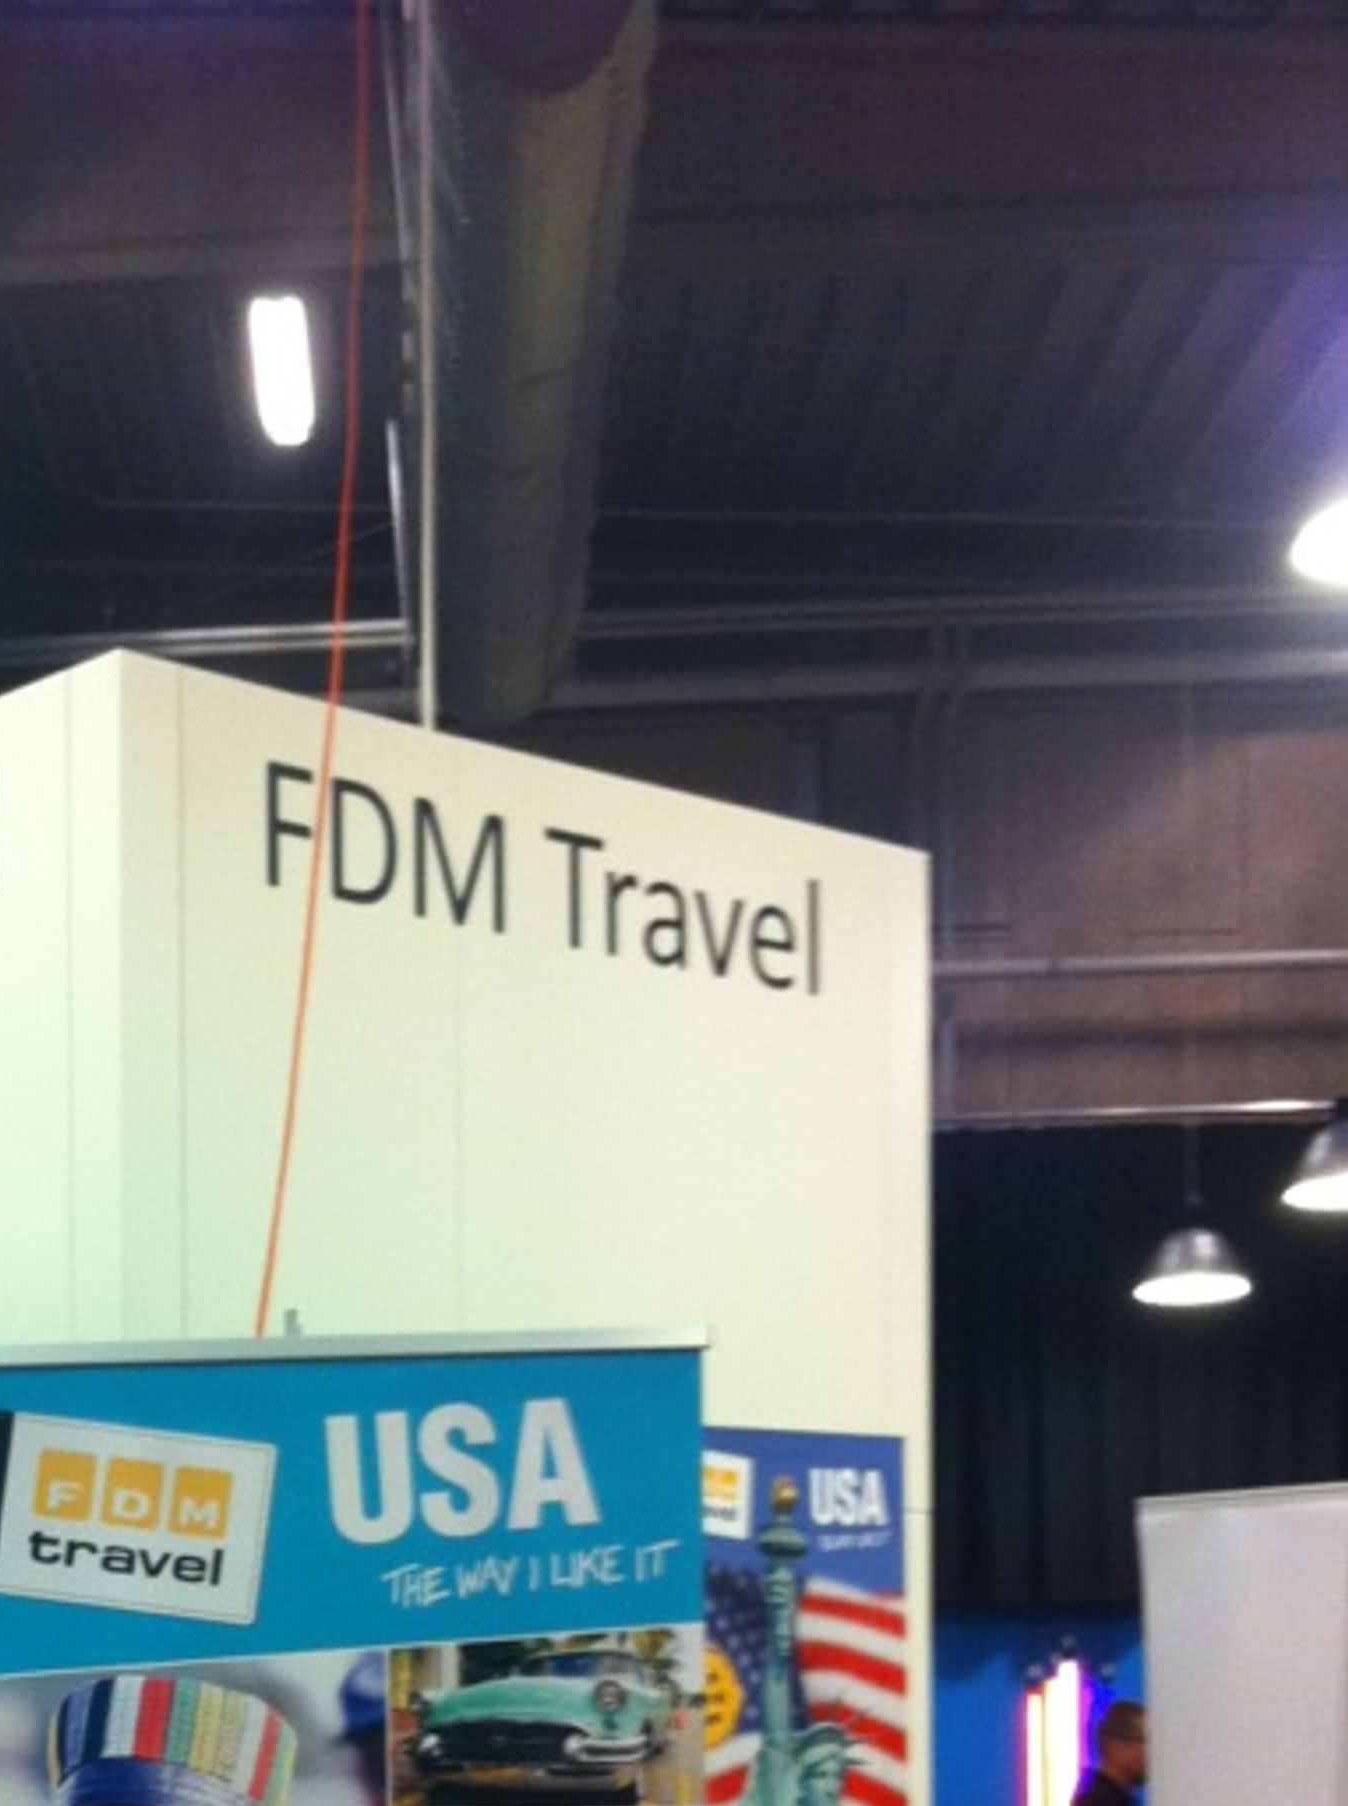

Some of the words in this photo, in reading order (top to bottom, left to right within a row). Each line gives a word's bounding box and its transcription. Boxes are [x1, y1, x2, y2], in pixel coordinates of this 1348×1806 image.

[263, 761, 507, 935] FDM
[544, 826, 824, 997] Travel
[324, 1397, 603, 1545] USA
[808, 1467, 891, 1527] USA
[41, 1476, 226, 1533] FDM
[28, 1528, 226, 1587] travel
[381, 1567, 451, 1608] THE
[455, 1561, 519, 1600] WAY
[528, 1558, 540, 1592] I
[550, 1546, 626, 1588] LIKE
[634, 1540, 679, 1581] IT
